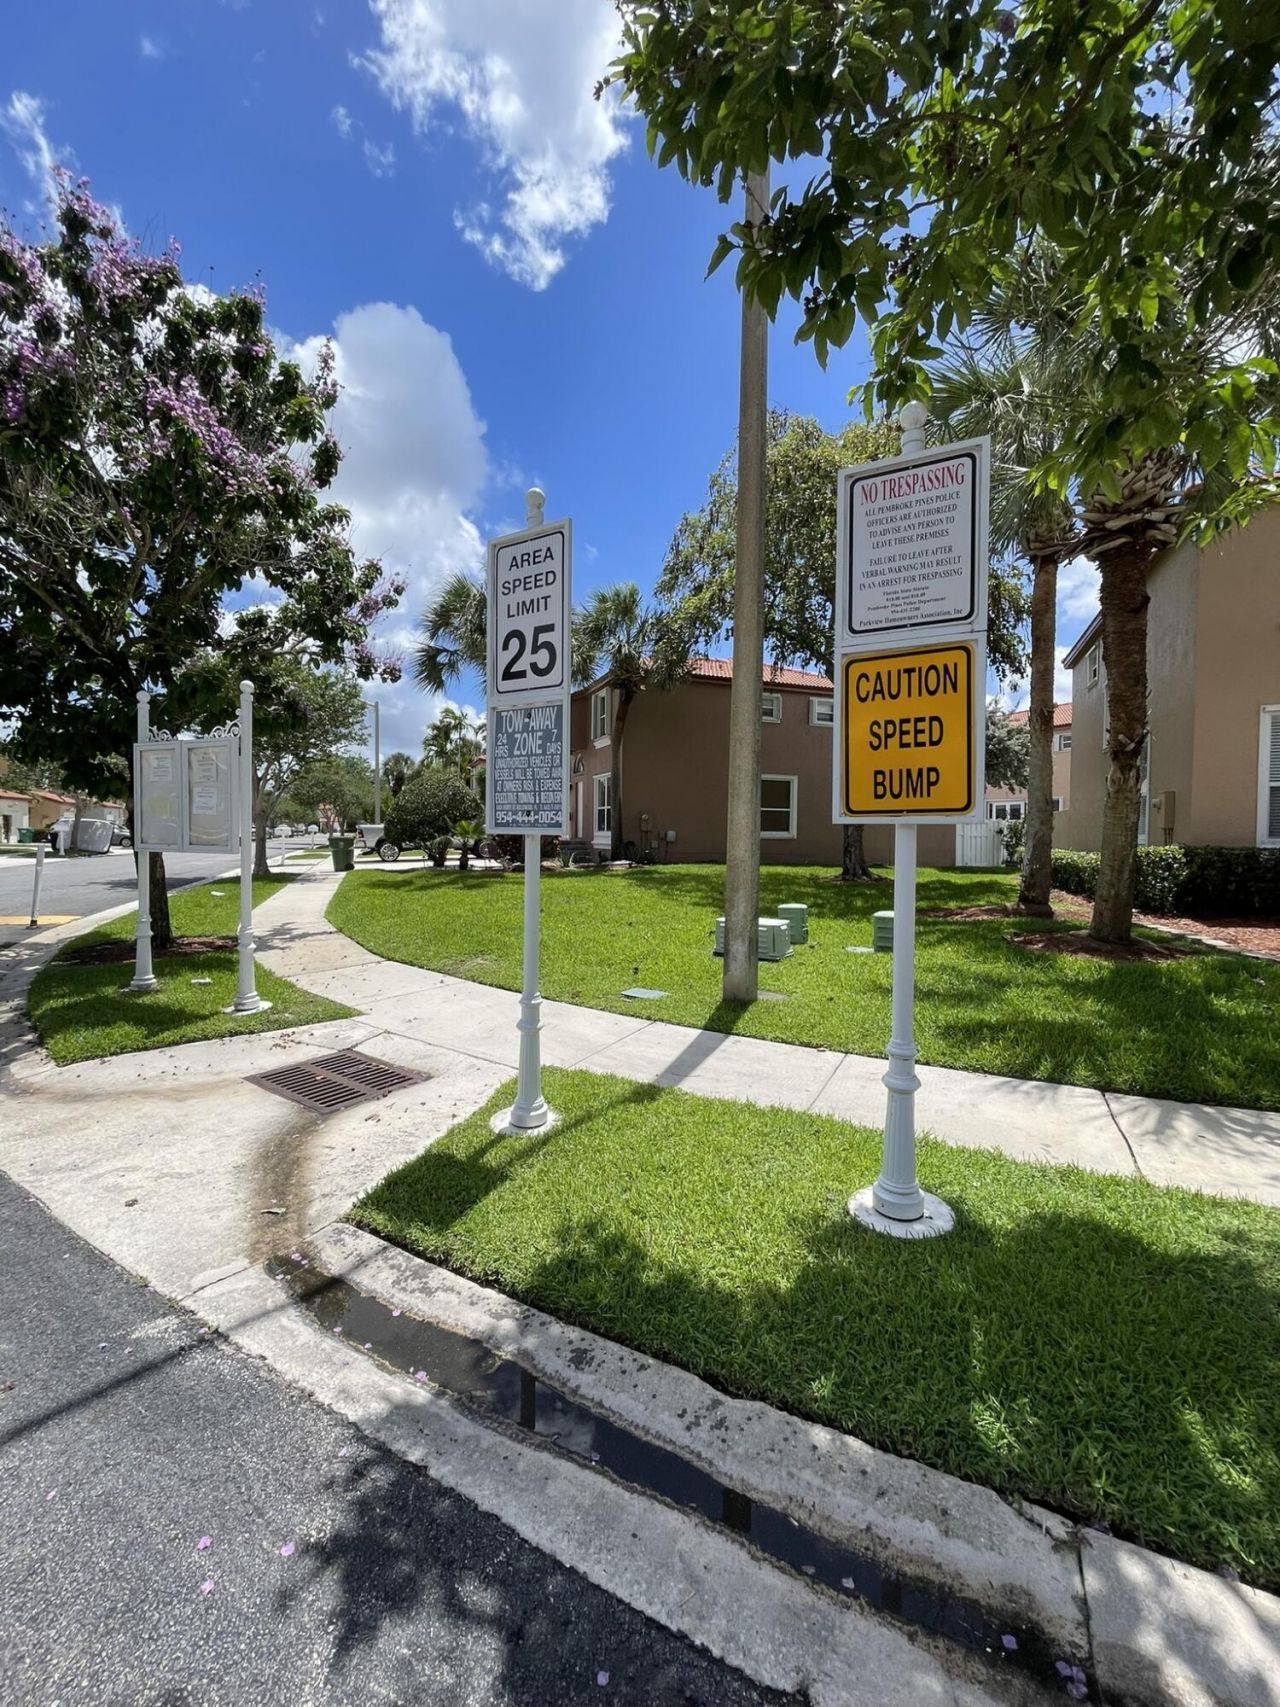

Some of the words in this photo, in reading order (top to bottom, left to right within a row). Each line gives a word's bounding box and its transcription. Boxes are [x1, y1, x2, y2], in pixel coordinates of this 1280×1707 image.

[861, 482, 878, 505] NO
[881, 463, 965, 501] TRESPASSING
[865, 507, 876, 517] ALL
[877, 501, 913, 515] PEMBROKE
[915, 497, 934, 507] PINES
[935, 491, 961, 503] POLICE
[867, 515, 897, 528] OFFICERS
[899, 511, 912, 521] ARE
[914, 503, 958, 519] AUTHORIZED
[869, 531, 878, 539] TO
[879, 526, 902, 537] ADVISE
[903, 522, 916, 532] ANY
[917, 517, 944, 529] PERSON
[945, 516, 955, 525] TO
[872, 539, 893, 550] LEAVE
[894, 534, 914, 545] THESE
[916, 528, 950, 541] PREMISES
[508, 547, 554, 571] AREA
[870, 554, 897, 566] FAILURE
[898, 552, 908, 561] TO
[908, 548, 930, 559] LEAVE
[931, 545, 953, 556] AFTER
[859, 583, 866, 591] IN
[867, 581, 878, 590] AN
[878, 577, 902, 588] ARREST
[903, 574, 917, 584] FOR
[918, 567, 963, 582] TRESPASSING
[861, 567, 887, 579] VERBAL
[888, 562, 918, 575] WARNING
[920, 559, 934, 569] MAY
[935, 556, 962, 567] RESULT
[501, 570, 557, 596] SPEED
[507, 595, 551, 619] LIMIT
[917, 597, 946, 606] Department
[859, 619, 883, 627] Parkview
[884, 614, 919, 624] Homeowners
[953, 607, 963, 615] Inc
[501, 623, 557, 682] 25
[856, 662, 958, 703] CAUTION
[501, 706, 557, 733] TOW-AWAY
[497, 733, 507, 746] 24
[513, 731, 543, 756] ZONE
[551, 729, 558, 742] 7
[869, 715, 944, 751] SPEED
[495, 745, 509, 758] HRS
[546, 741, 561, 755] DAYS
[495, 757, 529, 769] UNAUTHORIZED
[529, 755, 552, 767] VEHICLES
[552, 754, 561, 766] OR
[496, 780, 502, 792] AT
[523, 779, 535, 791] RISK
[540, 778, 562, 791] EXPENSE
[514, 768, 526, 780] WILL
[526, 768, 533, 779] BE
[534, 767, 550, 779] TOWED
[873, 767, 940, 800] BUMP
[496, 810, 562, 824] 954-444-0054
